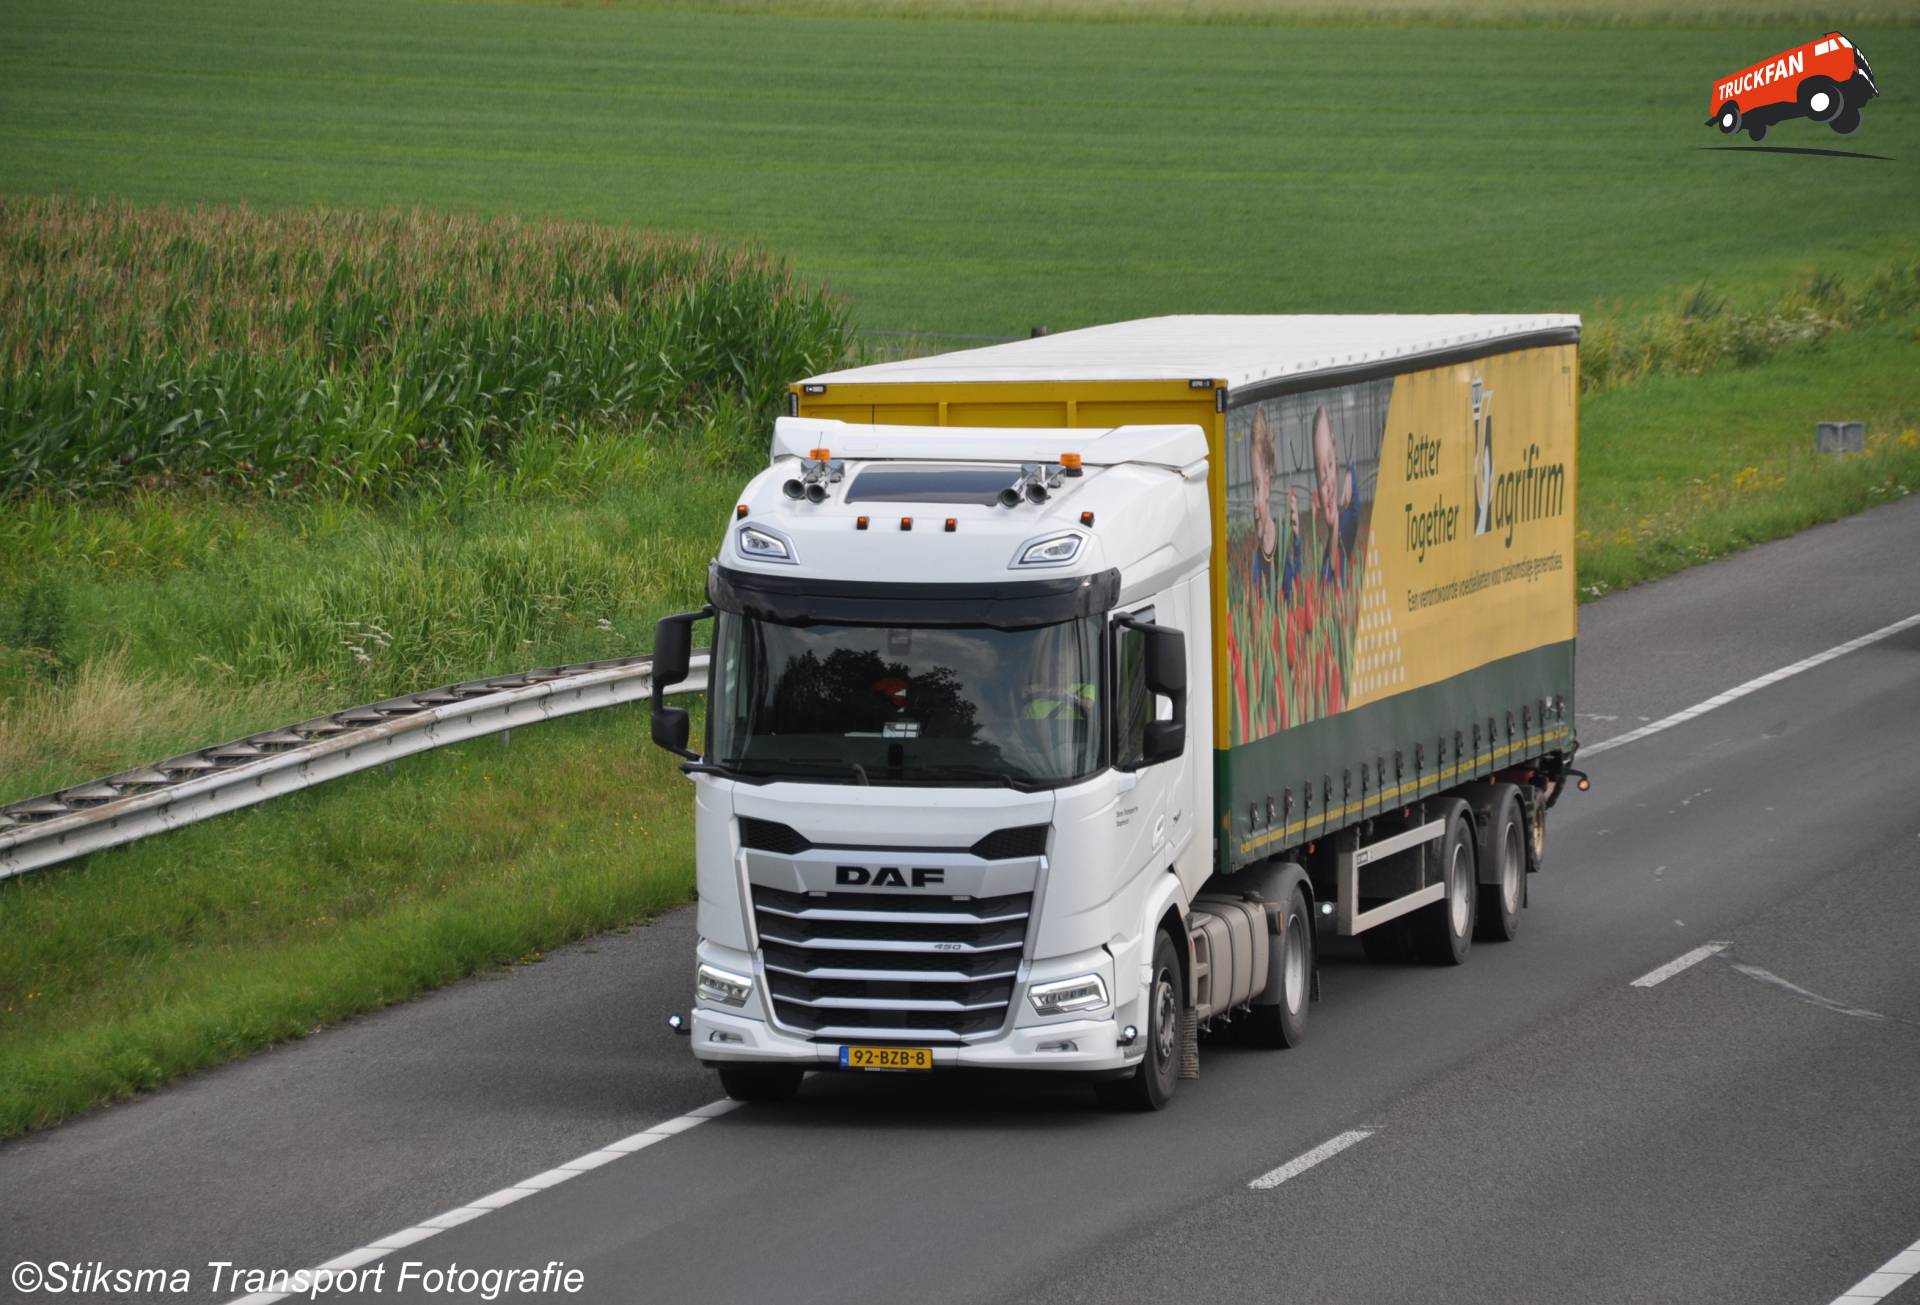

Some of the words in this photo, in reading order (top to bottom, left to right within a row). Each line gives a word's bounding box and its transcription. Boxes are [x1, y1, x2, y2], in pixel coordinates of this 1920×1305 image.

[1406, 432, 1441, 481] Better
[1496, 443, 1564, 548] agrifirm
[1405, 494, 1459, 563] Together
[835, 866, 945, 888] DAF
[934, 943, 962, 951] 450
[854, 1050, 925, 1065] 92-BZB-8
